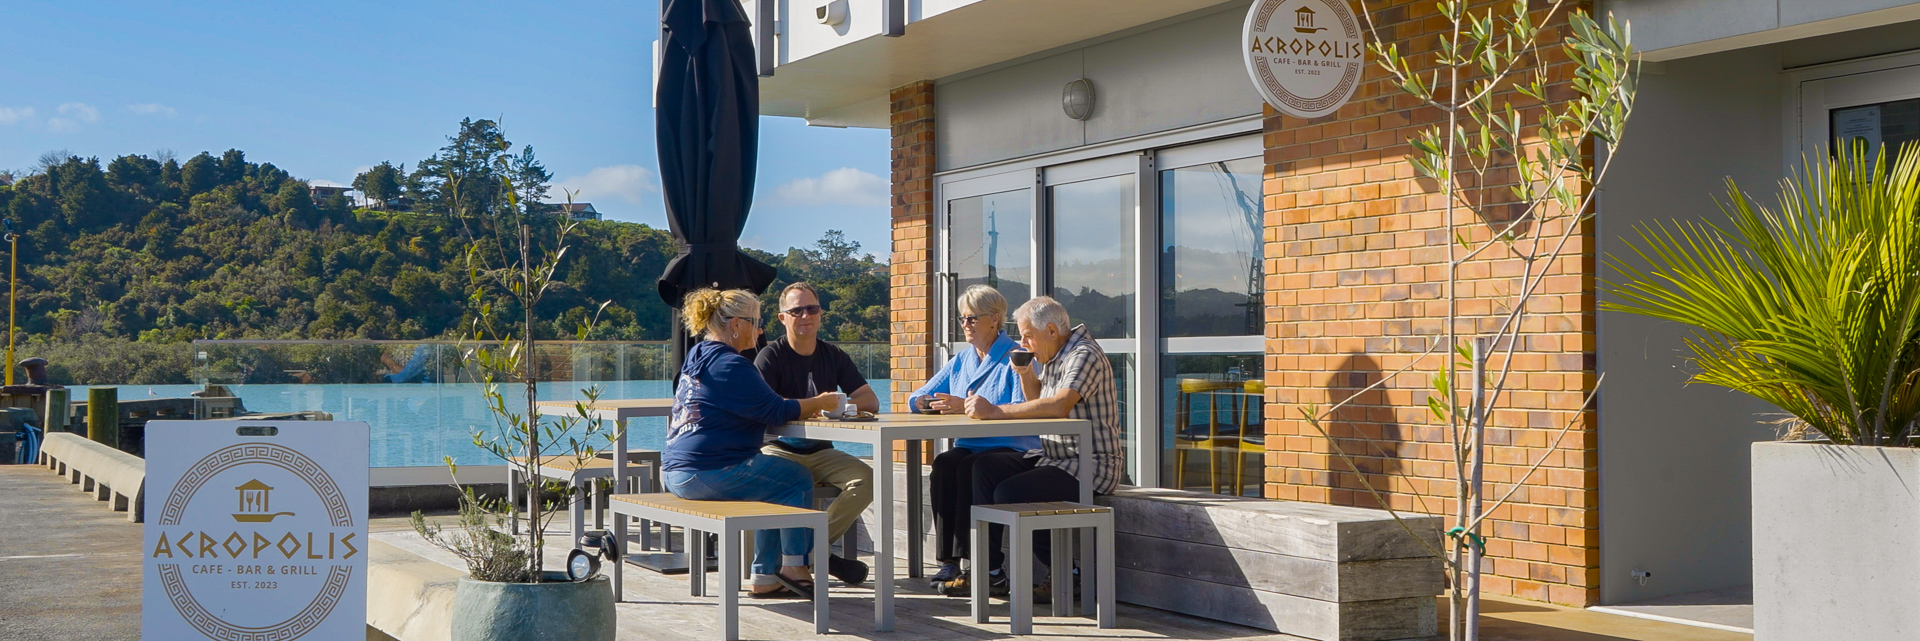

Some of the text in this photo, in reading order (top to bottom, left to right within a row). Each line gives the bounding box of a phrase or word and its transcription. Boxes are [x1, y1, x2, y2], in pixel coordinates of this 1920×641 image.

[1251, 35, 1361, 59] ACROPOLIS
[1273, 57, 1291, 65] CAFE
[1321, 60, 1341, 68] GRILL
[152, 530, 359, 560] ACROPOLIS
[192, 564, 223, 575] CAFE
[236, 565, 262, 575] BAR
[266, 565, 276, 575] &
[280, 565, 317, 576] GRILL
[230, 581, 278, 589] EST. 2023
